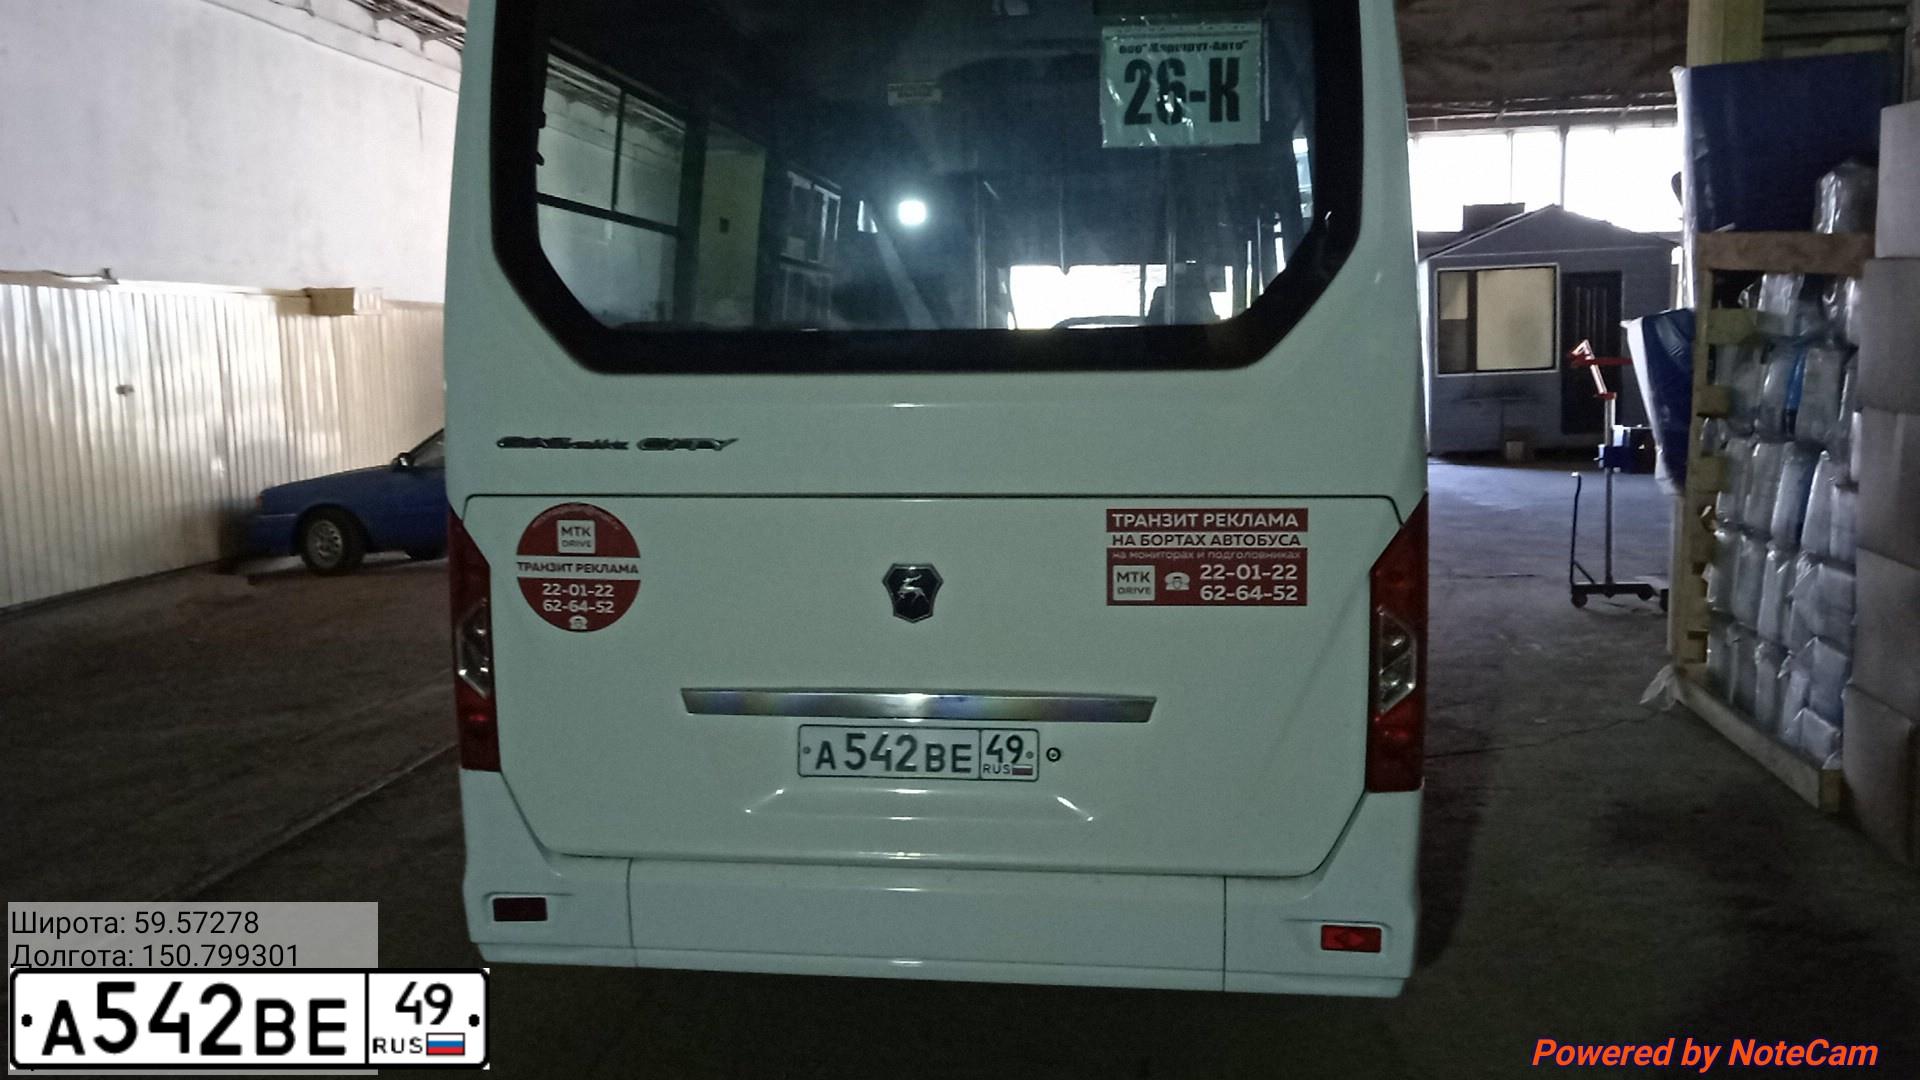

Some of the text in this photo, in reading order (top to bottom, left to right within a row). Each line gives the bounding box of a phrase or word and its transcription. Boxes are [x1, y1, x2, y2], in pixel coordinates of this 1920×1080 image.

[1112, 513, 1299, 527] ТРАНЗИТ РЕКЛАМА
[562, 540, 592, 548] DRIVE
[1112, 534, 1302, 546] НА БОРТАХ АВТОБУСА
[1129, 551, 1194, 560] мониторах
[1207, 551, 1300, 560] подголовниках
[517, 561, 639, 574] ТРАНЗИТ РЕКЛАМА
[1200, 564, 1298, 580] 22-01-22
[542, 583, 614, 597] 22-01-22
[1117, 587, 1150, 595] DRIVE
[1200, 585, 1298, 601] 62-64-52
[543, 599, 614, 613] 62-64-52
[815, 732, 1024, 773] А542ВЕ 49
[983, 764, 1010, 775] RUS
